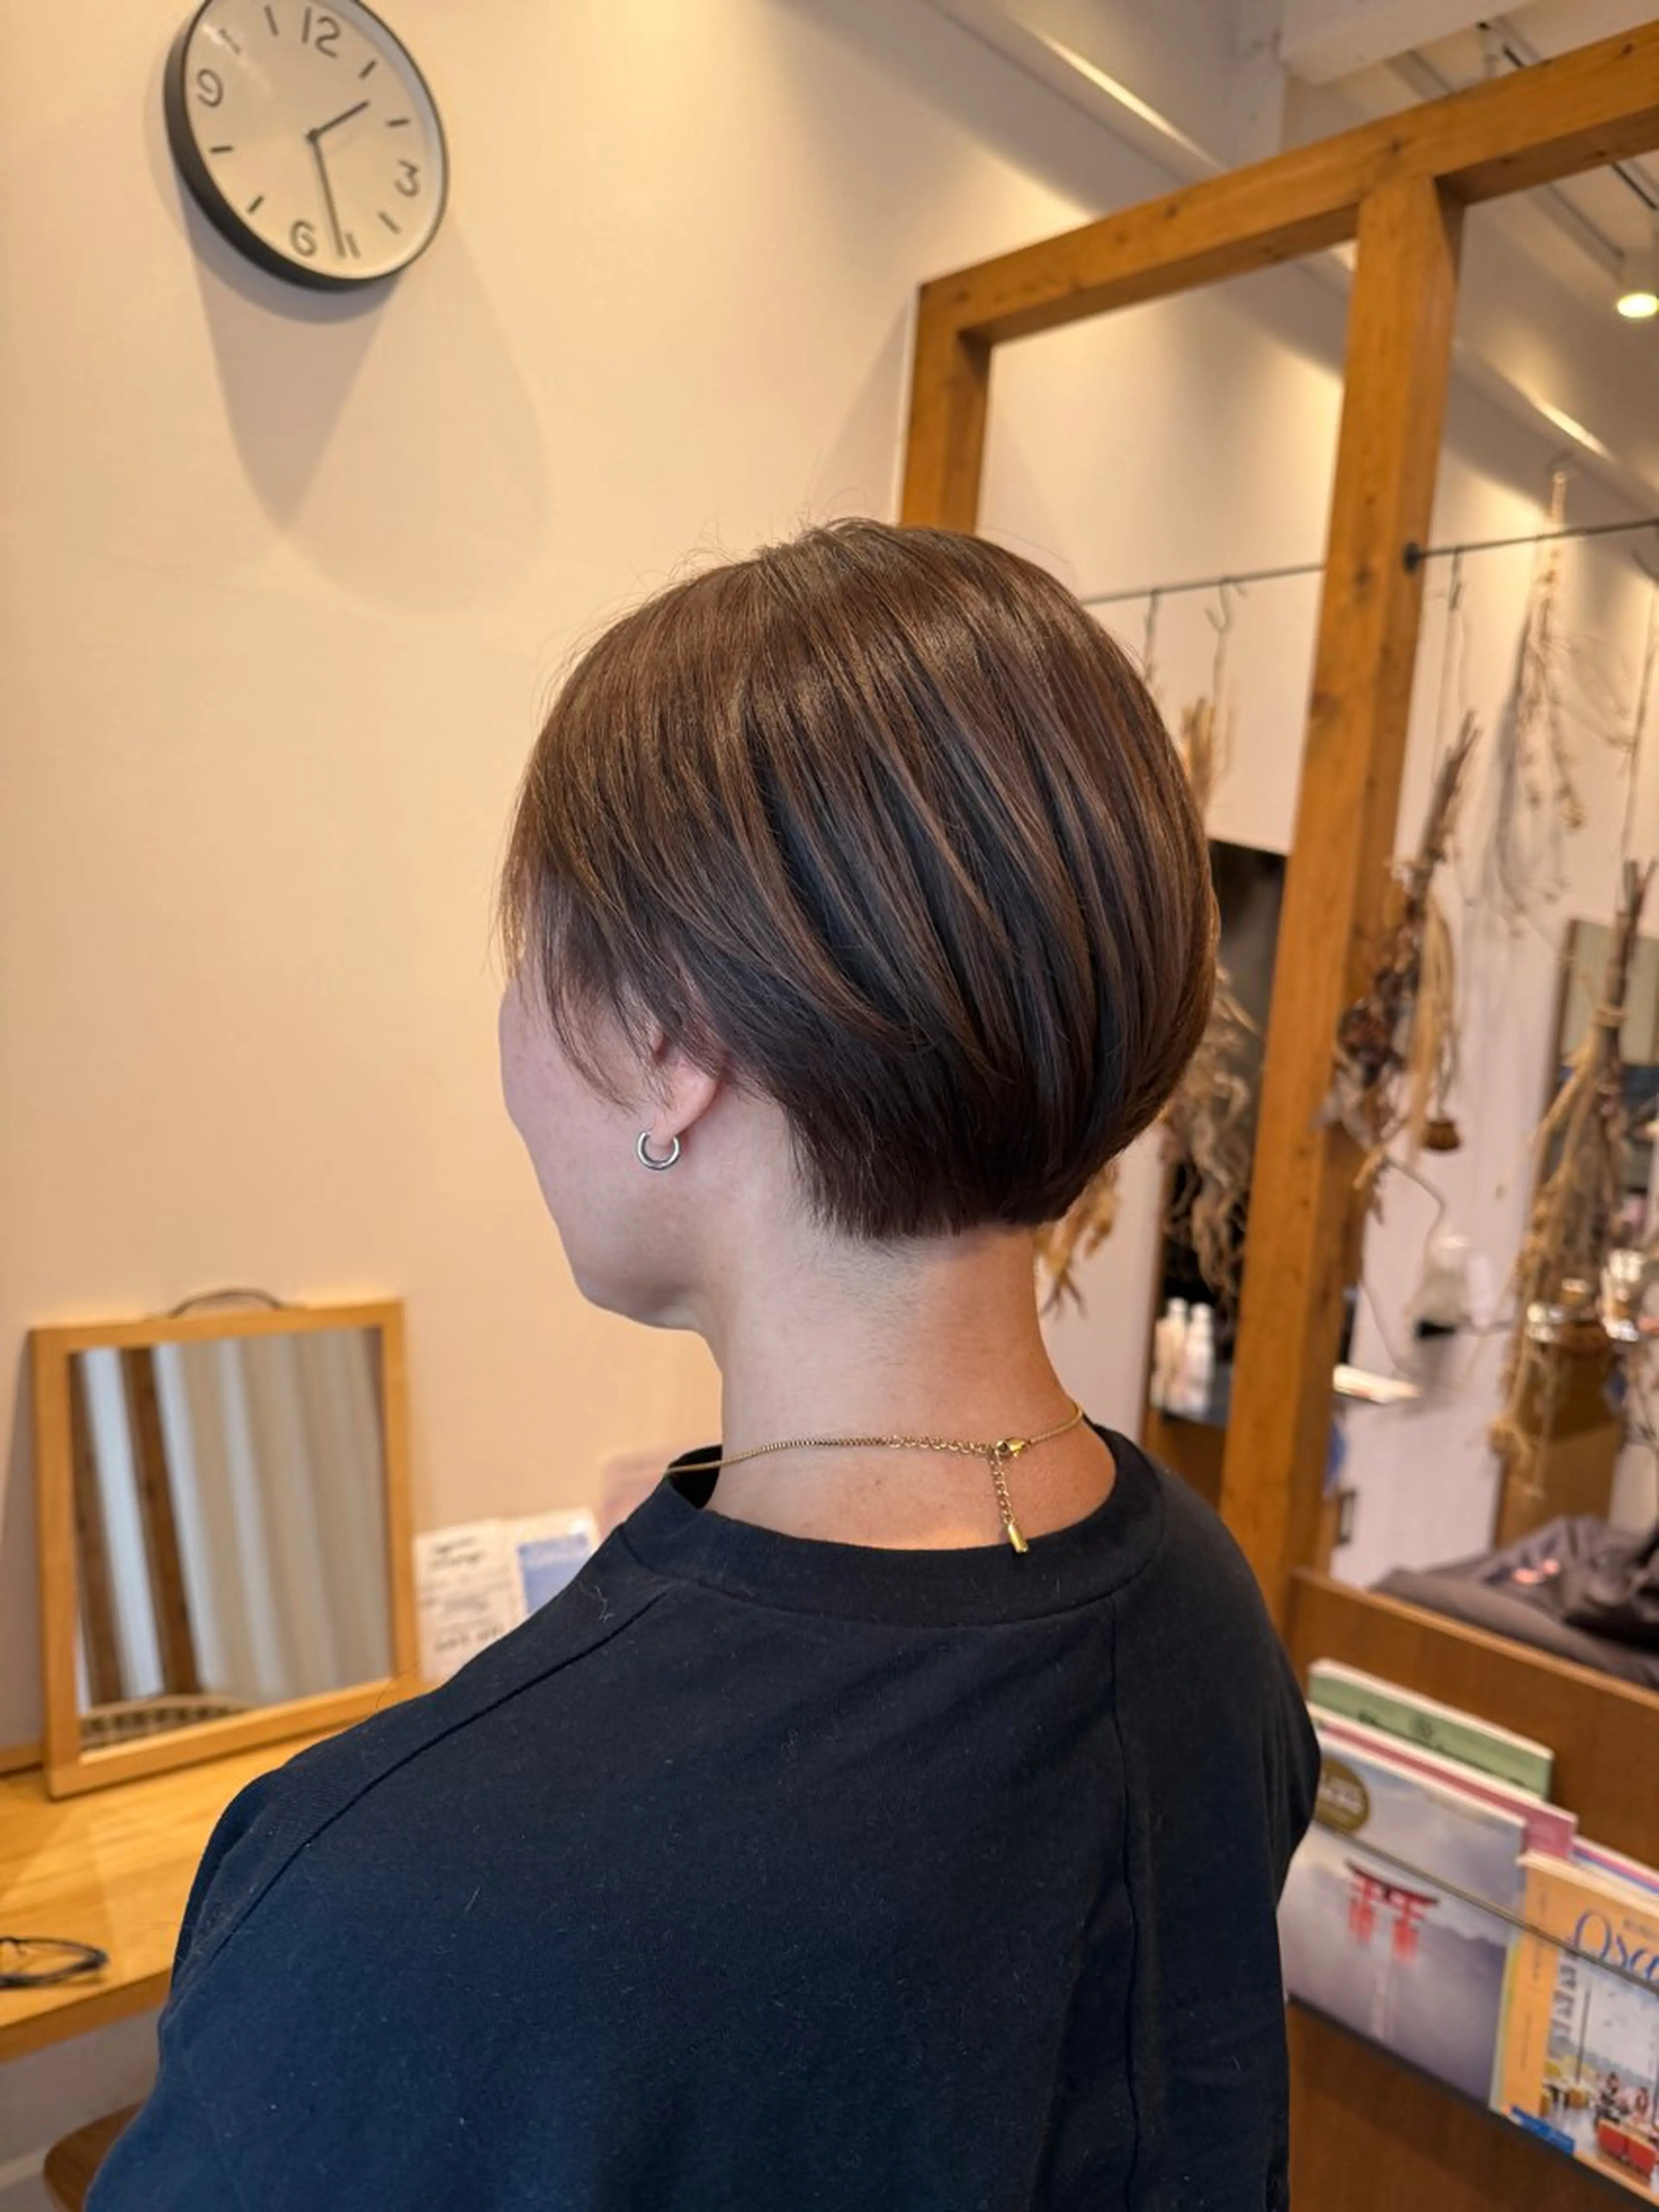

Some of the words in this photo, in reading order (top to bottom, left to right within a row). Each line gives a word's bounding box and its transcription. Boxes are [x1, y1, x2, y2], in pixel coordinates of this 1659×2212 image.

[302, 7, 340, 59] 12
[196, 68, 224, 108] 9
[394, 159, 420, 198] 3
[289, 219, 318, 257] 6
